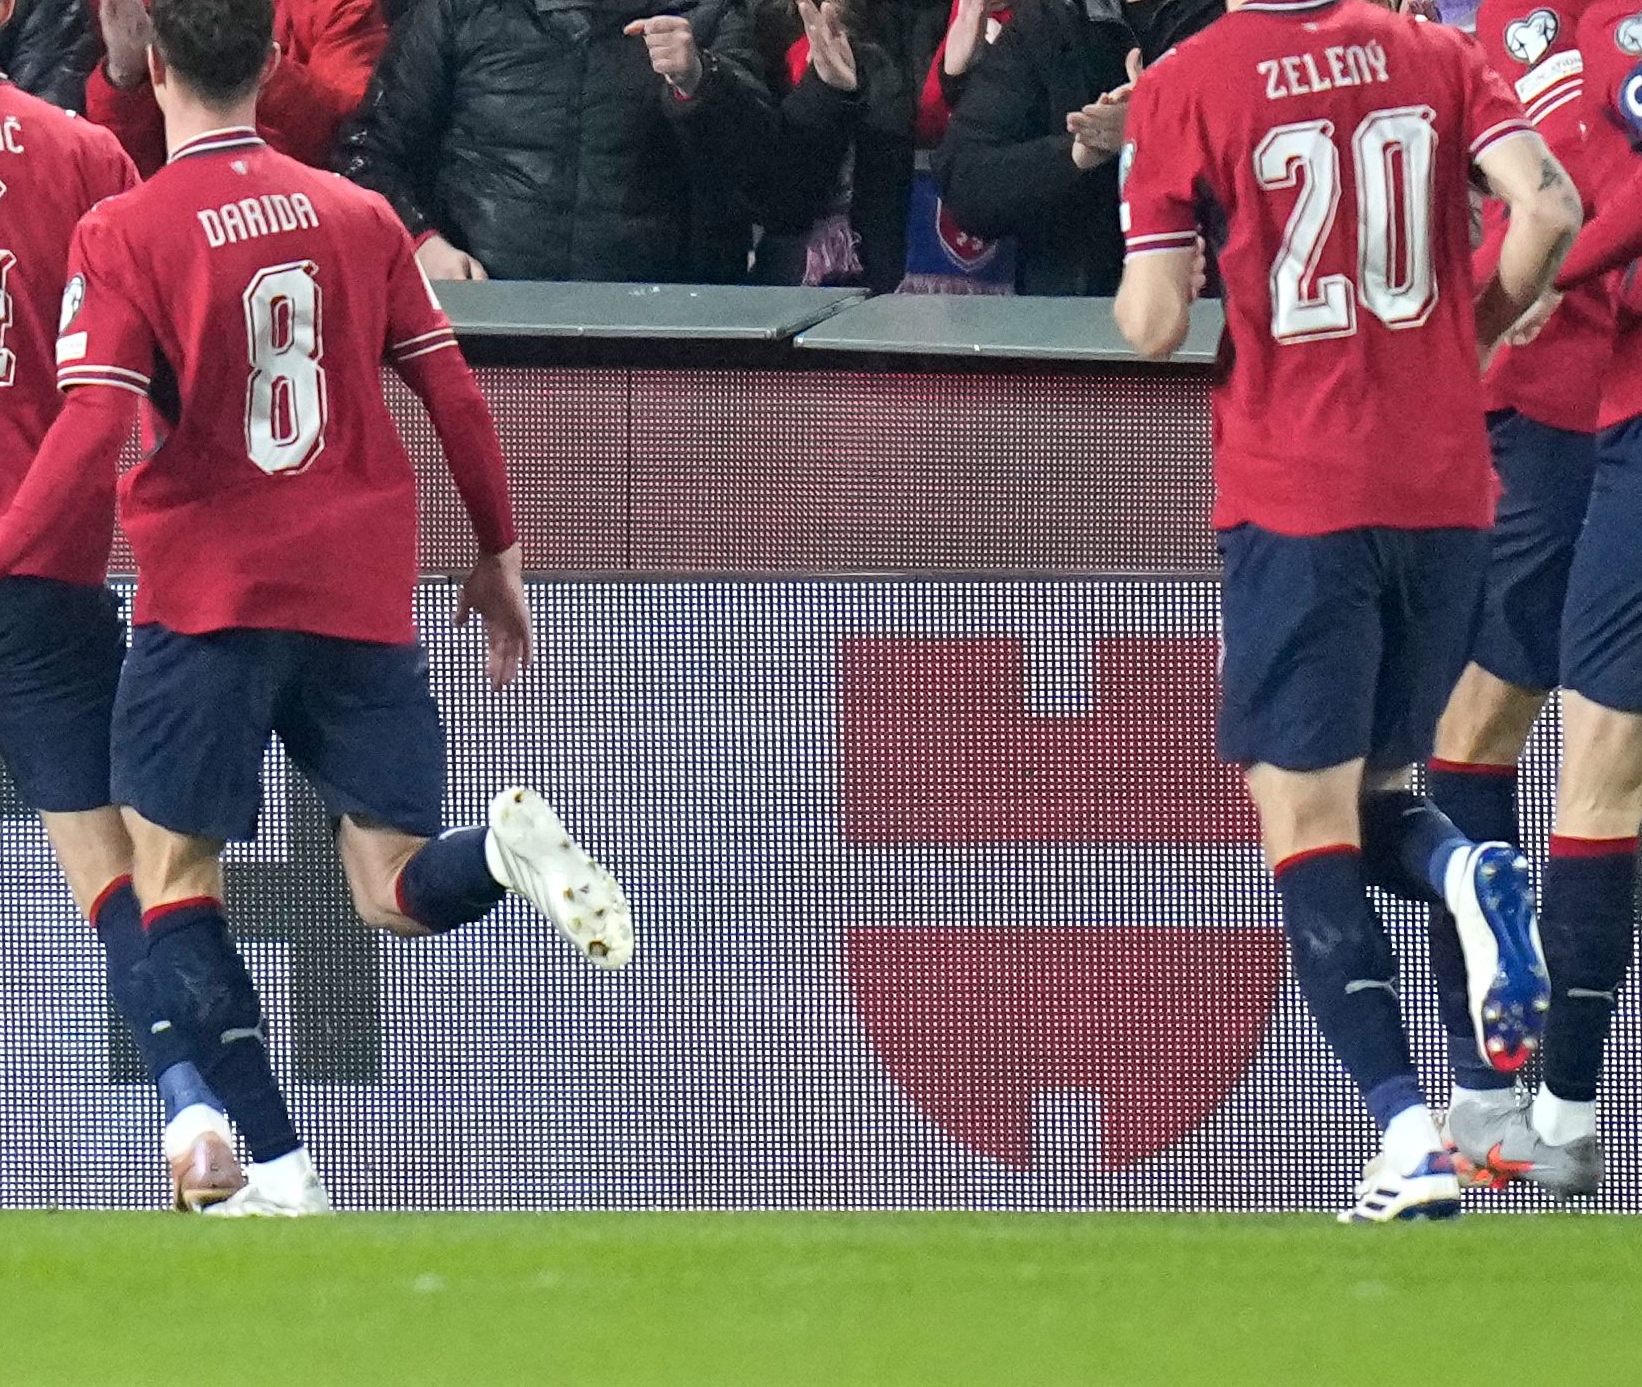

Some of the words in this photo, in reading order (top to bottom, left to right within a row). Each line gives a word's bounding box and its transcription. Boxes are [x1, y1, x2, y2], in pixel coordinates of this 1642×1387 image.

[1256, 37, 1389, 101] ZELENÝ
[197, 192, 320, 248] DARIDA
[1253, 105, 1441, 346] 20
[242, 259, 328, 477] 8
